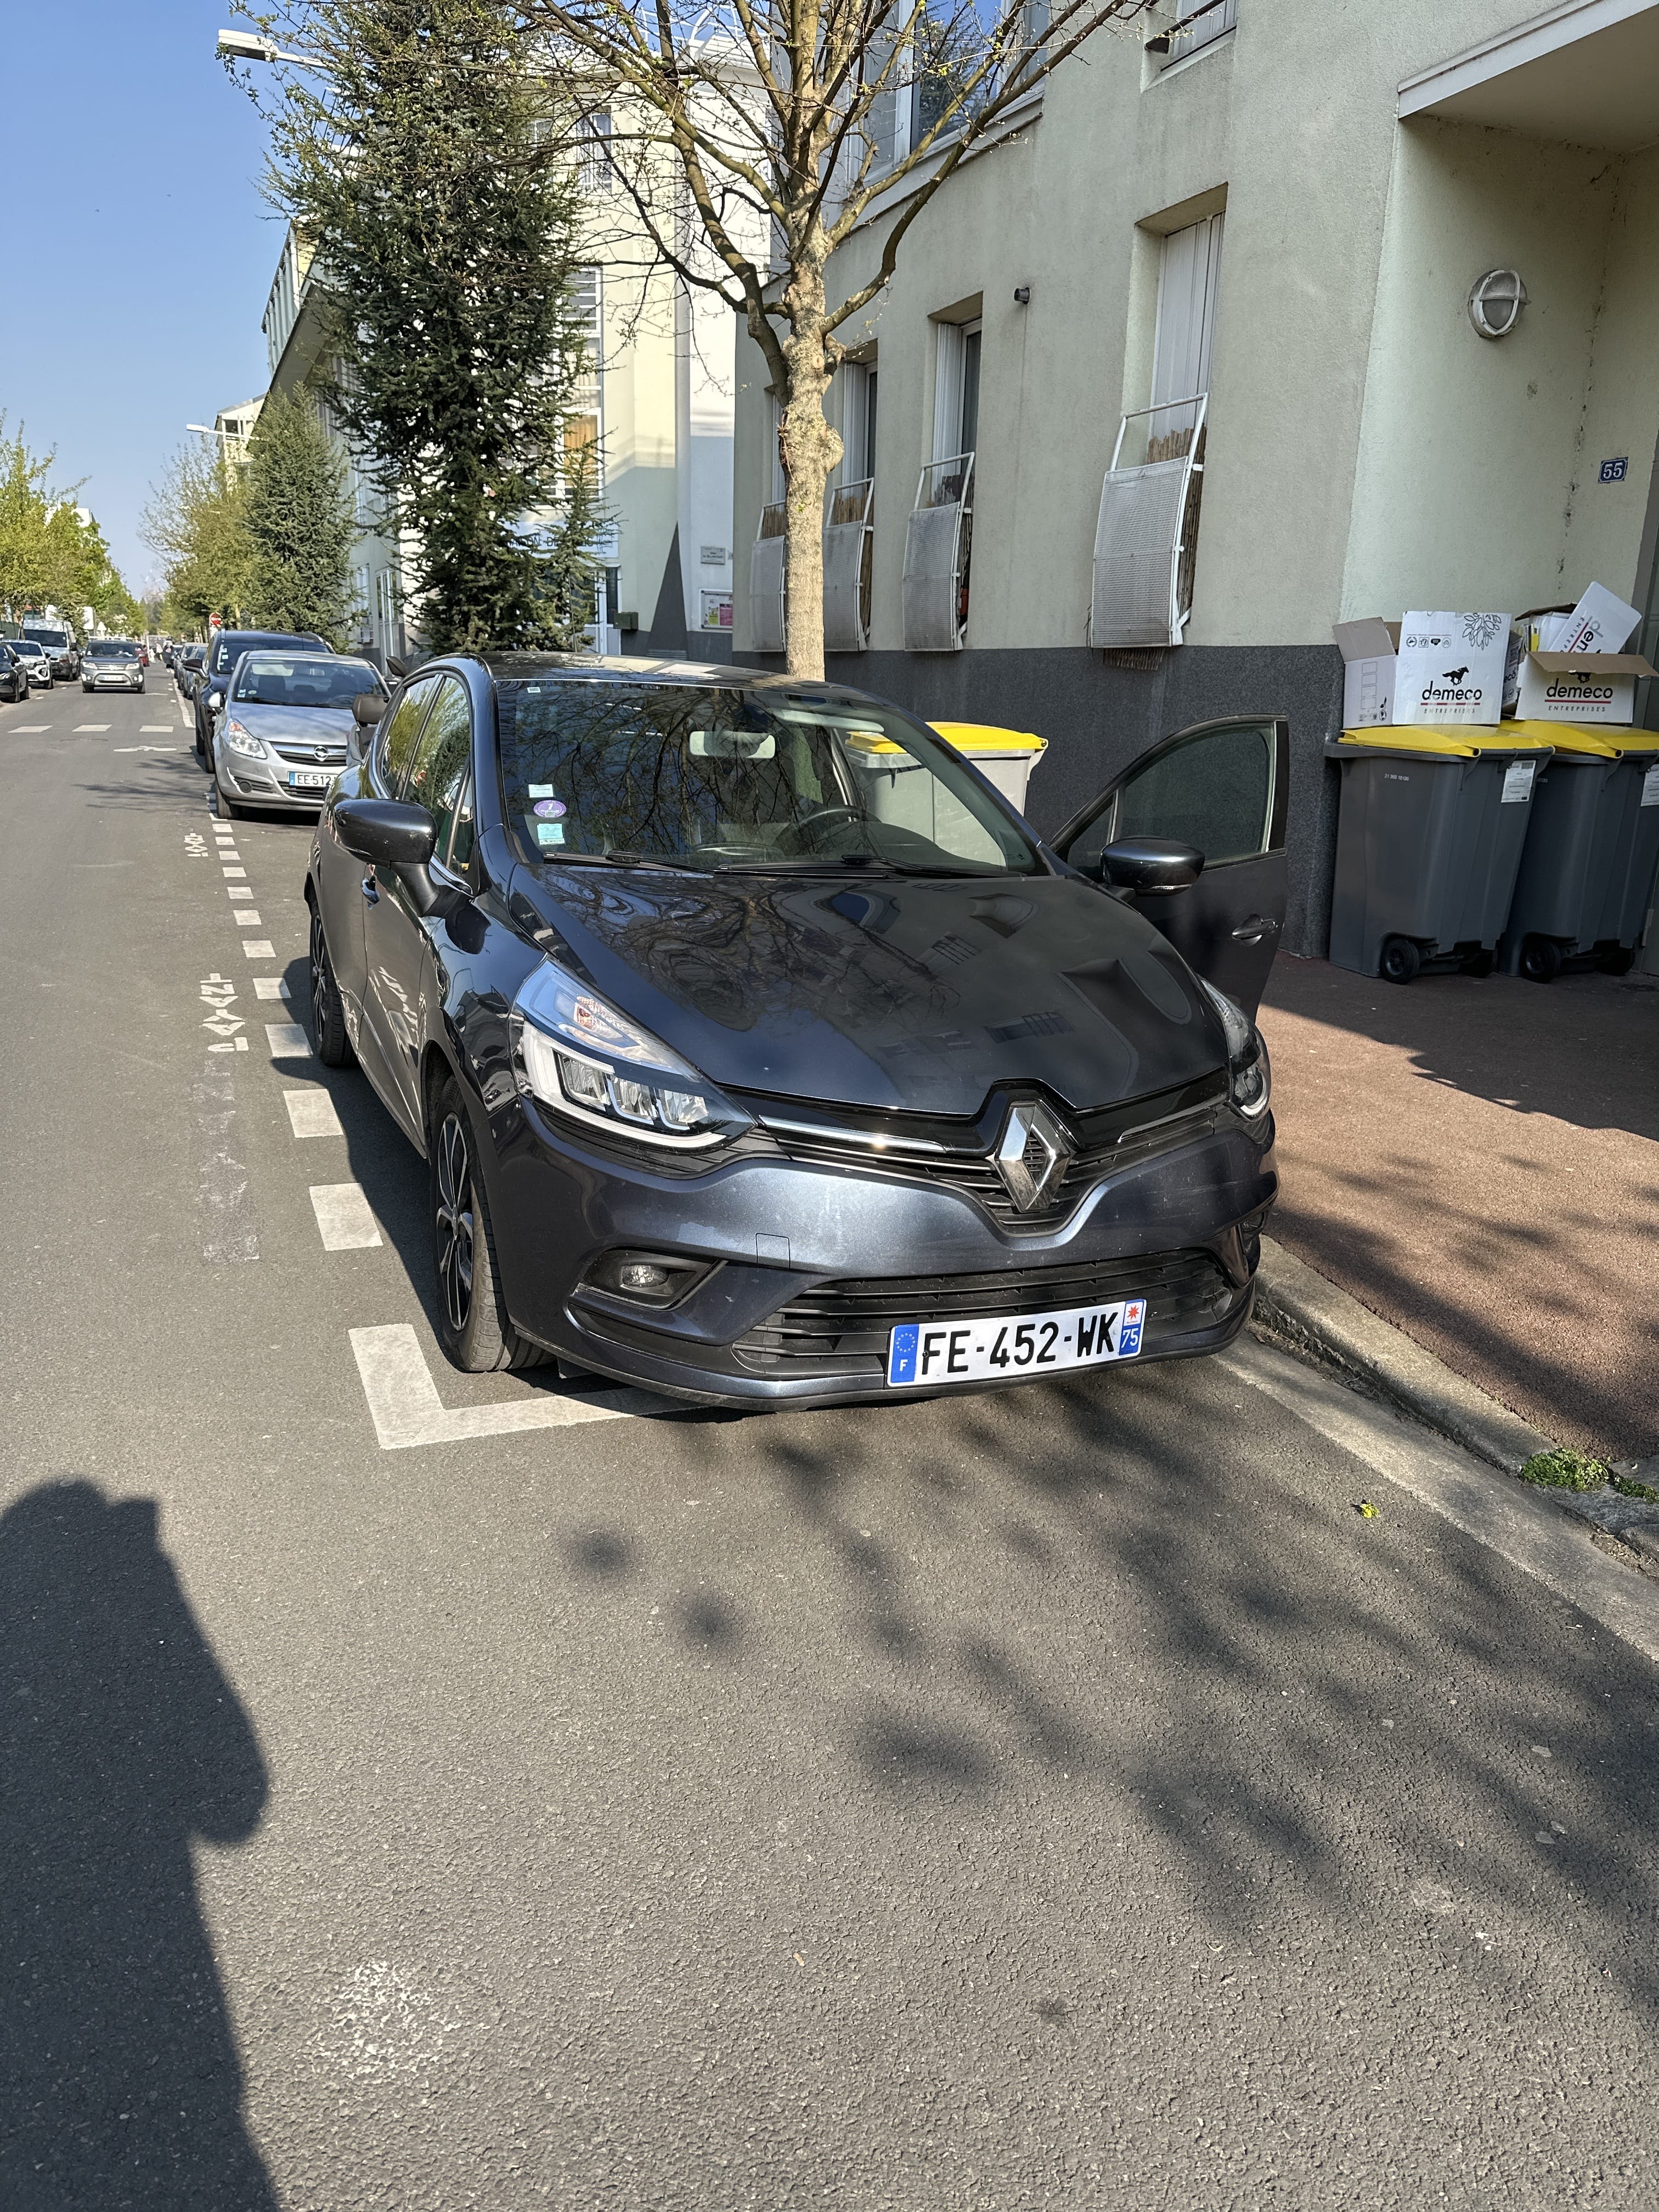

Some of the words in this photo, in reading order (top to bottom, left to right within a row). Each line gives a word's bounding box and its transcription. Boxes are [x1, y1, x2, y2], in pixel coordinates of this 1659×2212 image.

[1603, 462, 1623, 479] 55
[1422, 680, 1482, 701] demeco
[1546, 678, 1613, 699] demeco
[922, 1312, 1119, 1375] FE-452-WK
[1121, 1328, 1139, 1348] 75
[899, 1359, 909, 1372] F
